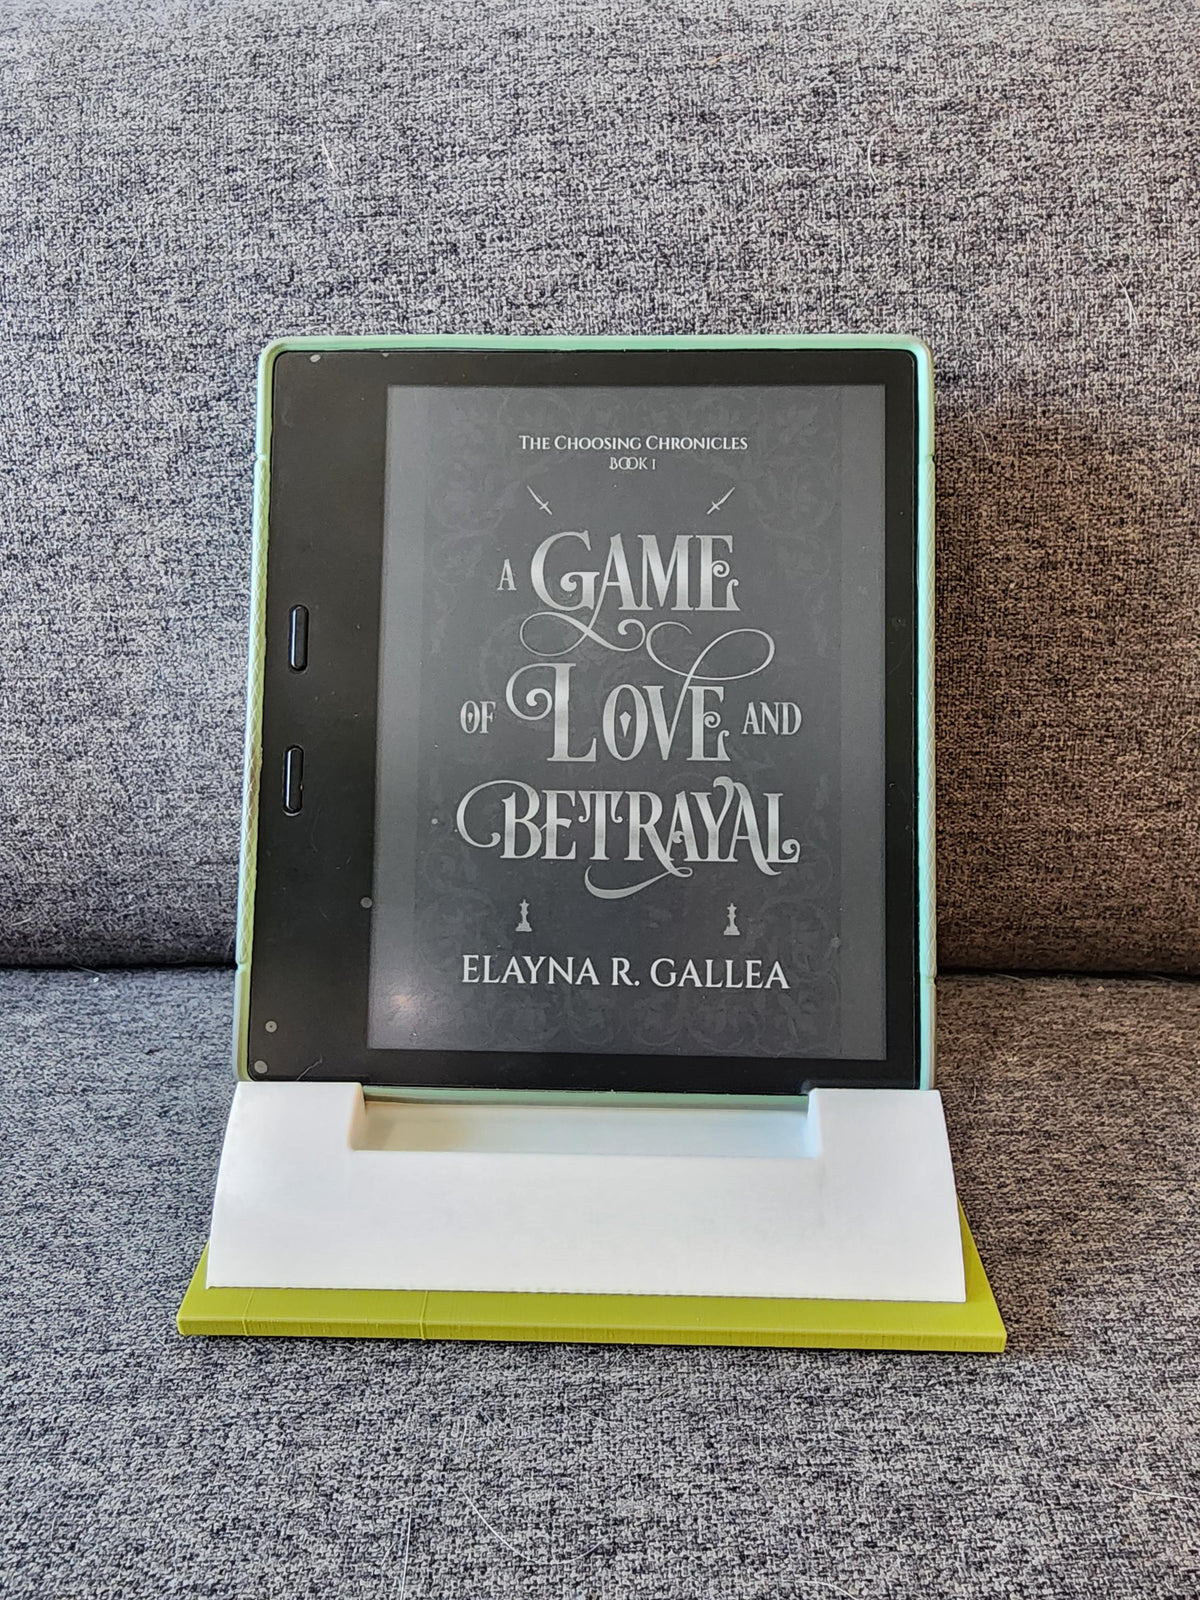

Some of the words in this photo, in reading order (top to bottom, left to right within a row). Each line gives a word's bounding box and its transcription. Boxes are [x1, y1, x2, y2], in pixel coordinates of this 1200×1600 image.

[519, 434, 551, 451] THE
[554, 434, 642, 451] CHOOSING
[645, 435, 748, 451] CHRONICLES
[609, 456, 648, 470] BOOK
[497, 558, 517, 591] A
[519, 530, 741, 656] GAME
[460, 700, 496, 734] OF
[505, 621, 775, 762] LOVE
[741, 701, 802, 735] AND
[456, 776, 801, 899] BETRAYAL
[461, 954, 600, 986] ELAYNA
[611, 957, 641, 987] R.
[650, 957, 791, 989] GALLEA
